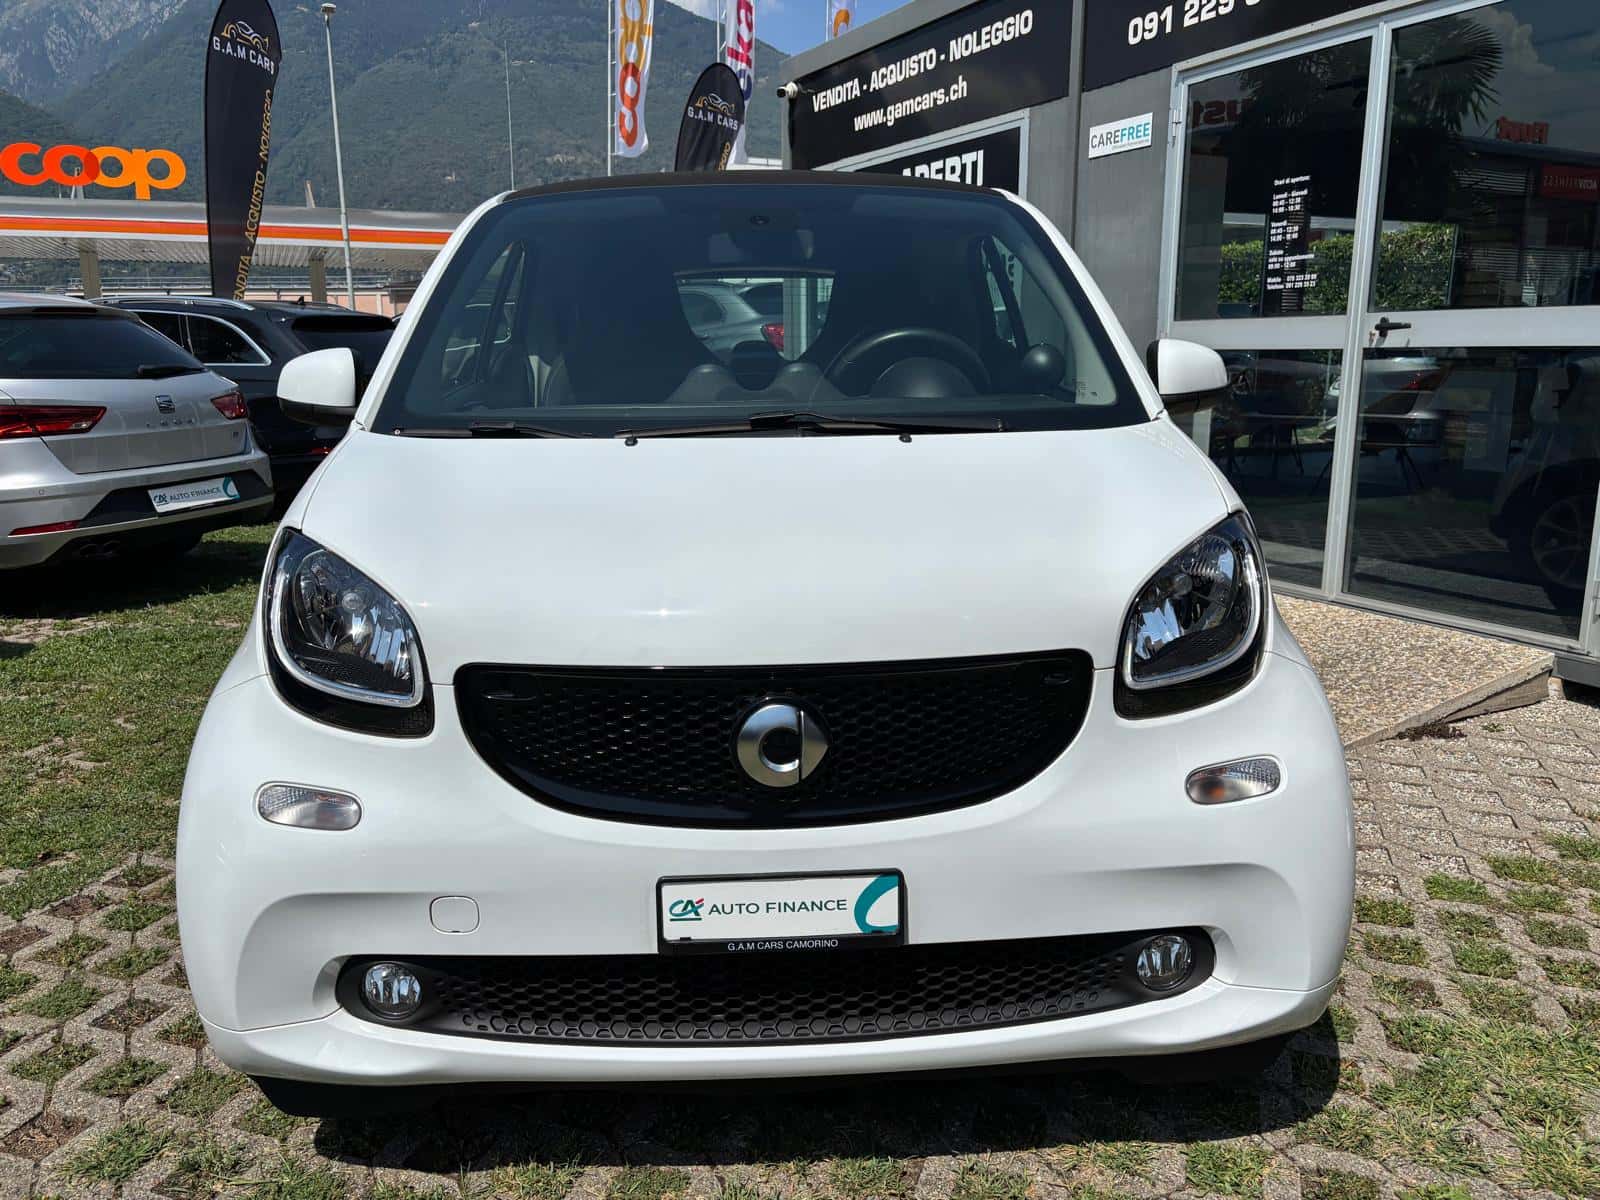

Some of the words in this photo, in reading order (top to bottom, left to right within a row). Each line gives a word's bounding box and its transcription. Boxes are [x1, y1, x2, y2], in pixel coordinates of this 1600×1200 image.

[1127, 4, 1173, 45] 091
[212, 35, 246, 60] G.A.M
[249, 49, 275, 75] CARS
[812, 78, 861, 113] VENDITA
[869, 47, 937, 93] ACQUISTO
[949, 9, 1033, 63] NOLEGGIO
[687, 106, 714, 123] G.A.M
[716, 114, 739, 130] CARS
[853, 74, 968, 132] www.gamcars.ch
[1090, 121, 1151, 149] CAREFREE
[0, 142, 187, 200] coop
[902, 149, 984, 187] ERTI
[233, 255, 252, 300] ENDITA
[244, 170, 265, 243] ACQUISTO
[708, 903, 760, 916] AUTO
[765, 899, 848, 914] FINANCE
[727, 941, 755, 952] G.A.M
[757, 940, 784, 950] CARS
[785, 939, 839, 950] CAMORINO
